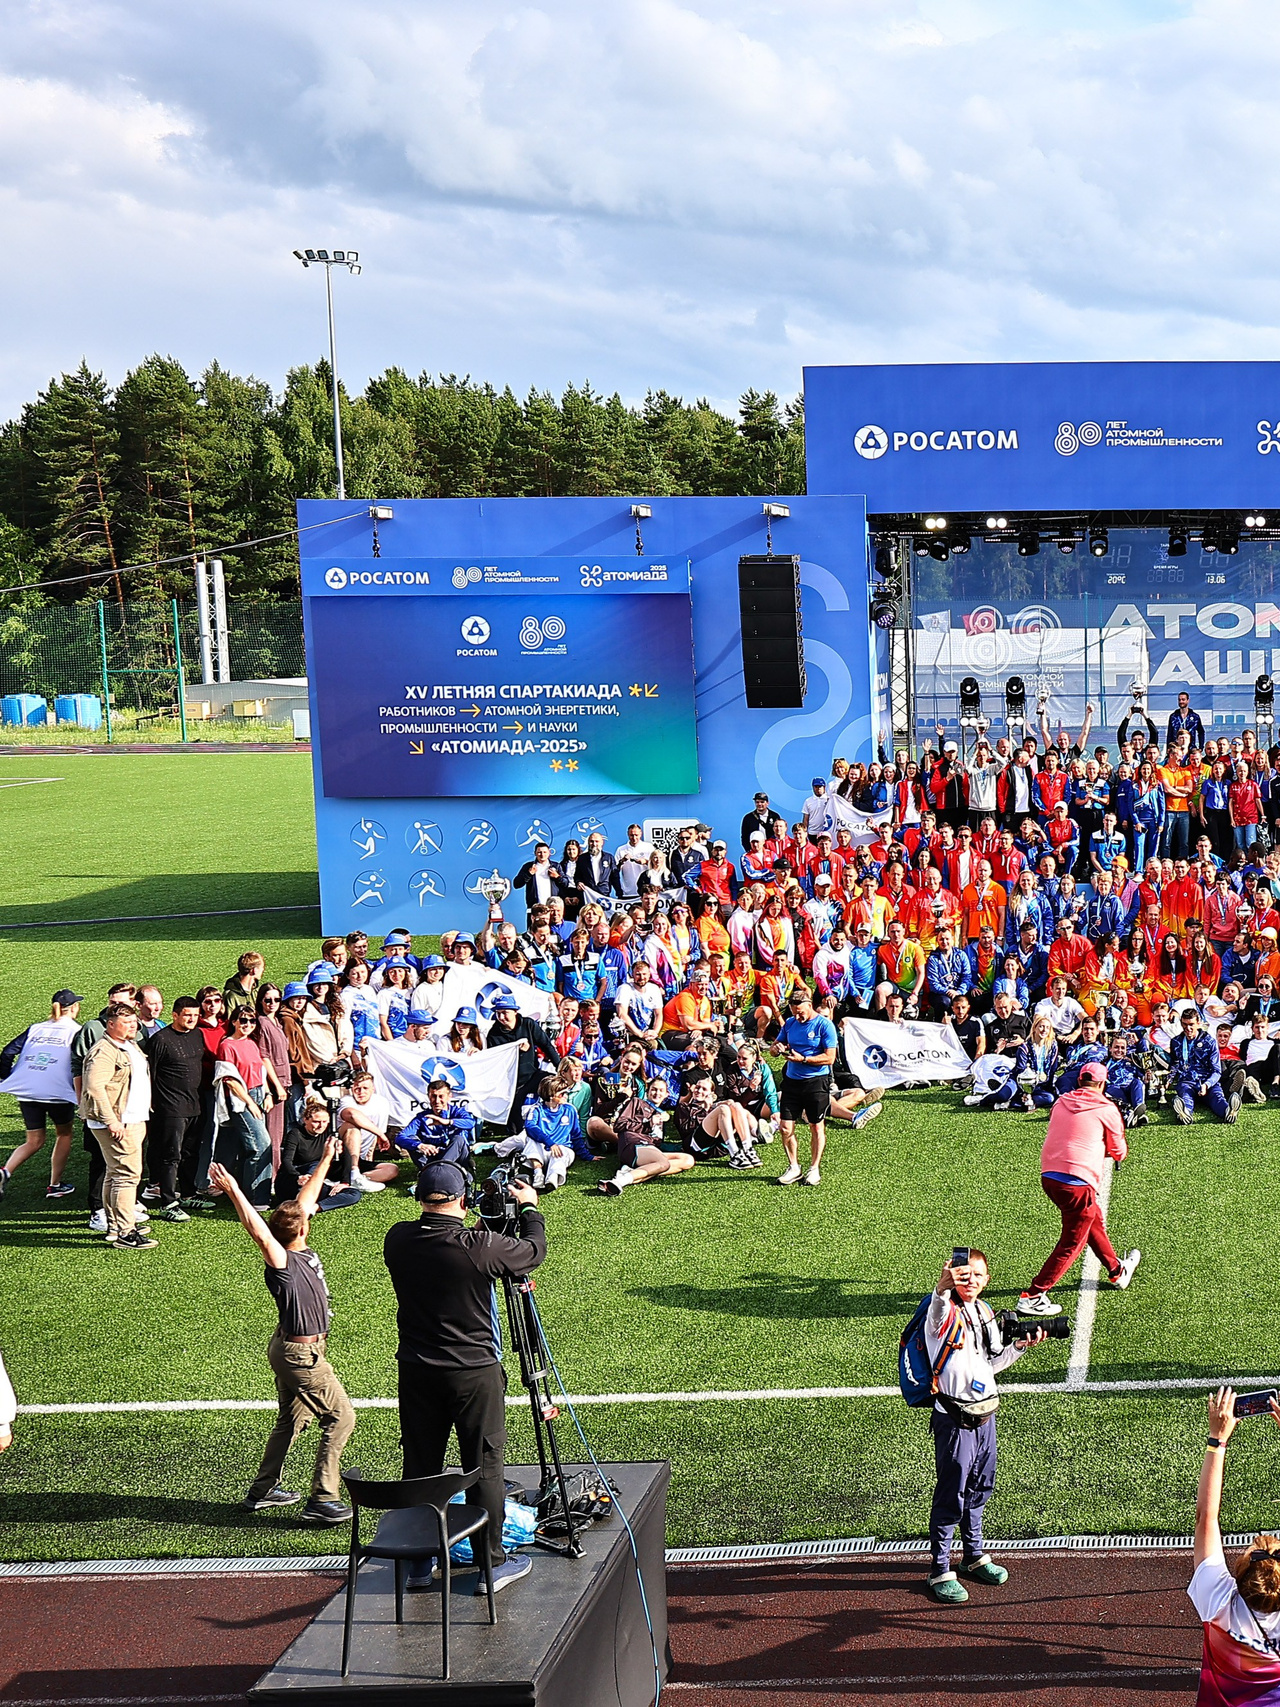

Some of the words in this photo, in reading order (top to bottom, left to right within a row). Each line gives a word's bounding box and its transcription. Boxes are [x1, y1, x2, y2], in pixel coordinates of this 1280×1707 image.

[1105, 427, 1164, 438] АТОМНОЙ
[893, 430, 1019, 451] РОСАТОМ
[1106, 438, 1223, 446] ПРОМЫШЛЕННОСТИ
[350, 571, 430, 585] РОСАТОМ
[602, 570, 668, 582] атомиада
[1206, 575, 1226, 584] 13.06
[404, 686, 428, 699] XV
[432, 685, 496, 699] ЛЕТНЯЯ
[500, 684, 622, 700] СПАРТАКИАДА
[379, 706, 456, 717] РАБОТНИКОВ
[484, 703, 542, 716] АТОМНОЙ
[544, 705, 620, 717] ЭНЕРГЕТИКИ,
[380, 722, 498, 734] ПРОМЫШЛЕННОСТИ
[527, 722, 537, 732] И
[539, 722, 578, 732] НАУКИ
[431, 739, 588, 755] «АТОМИАДА-2025»
